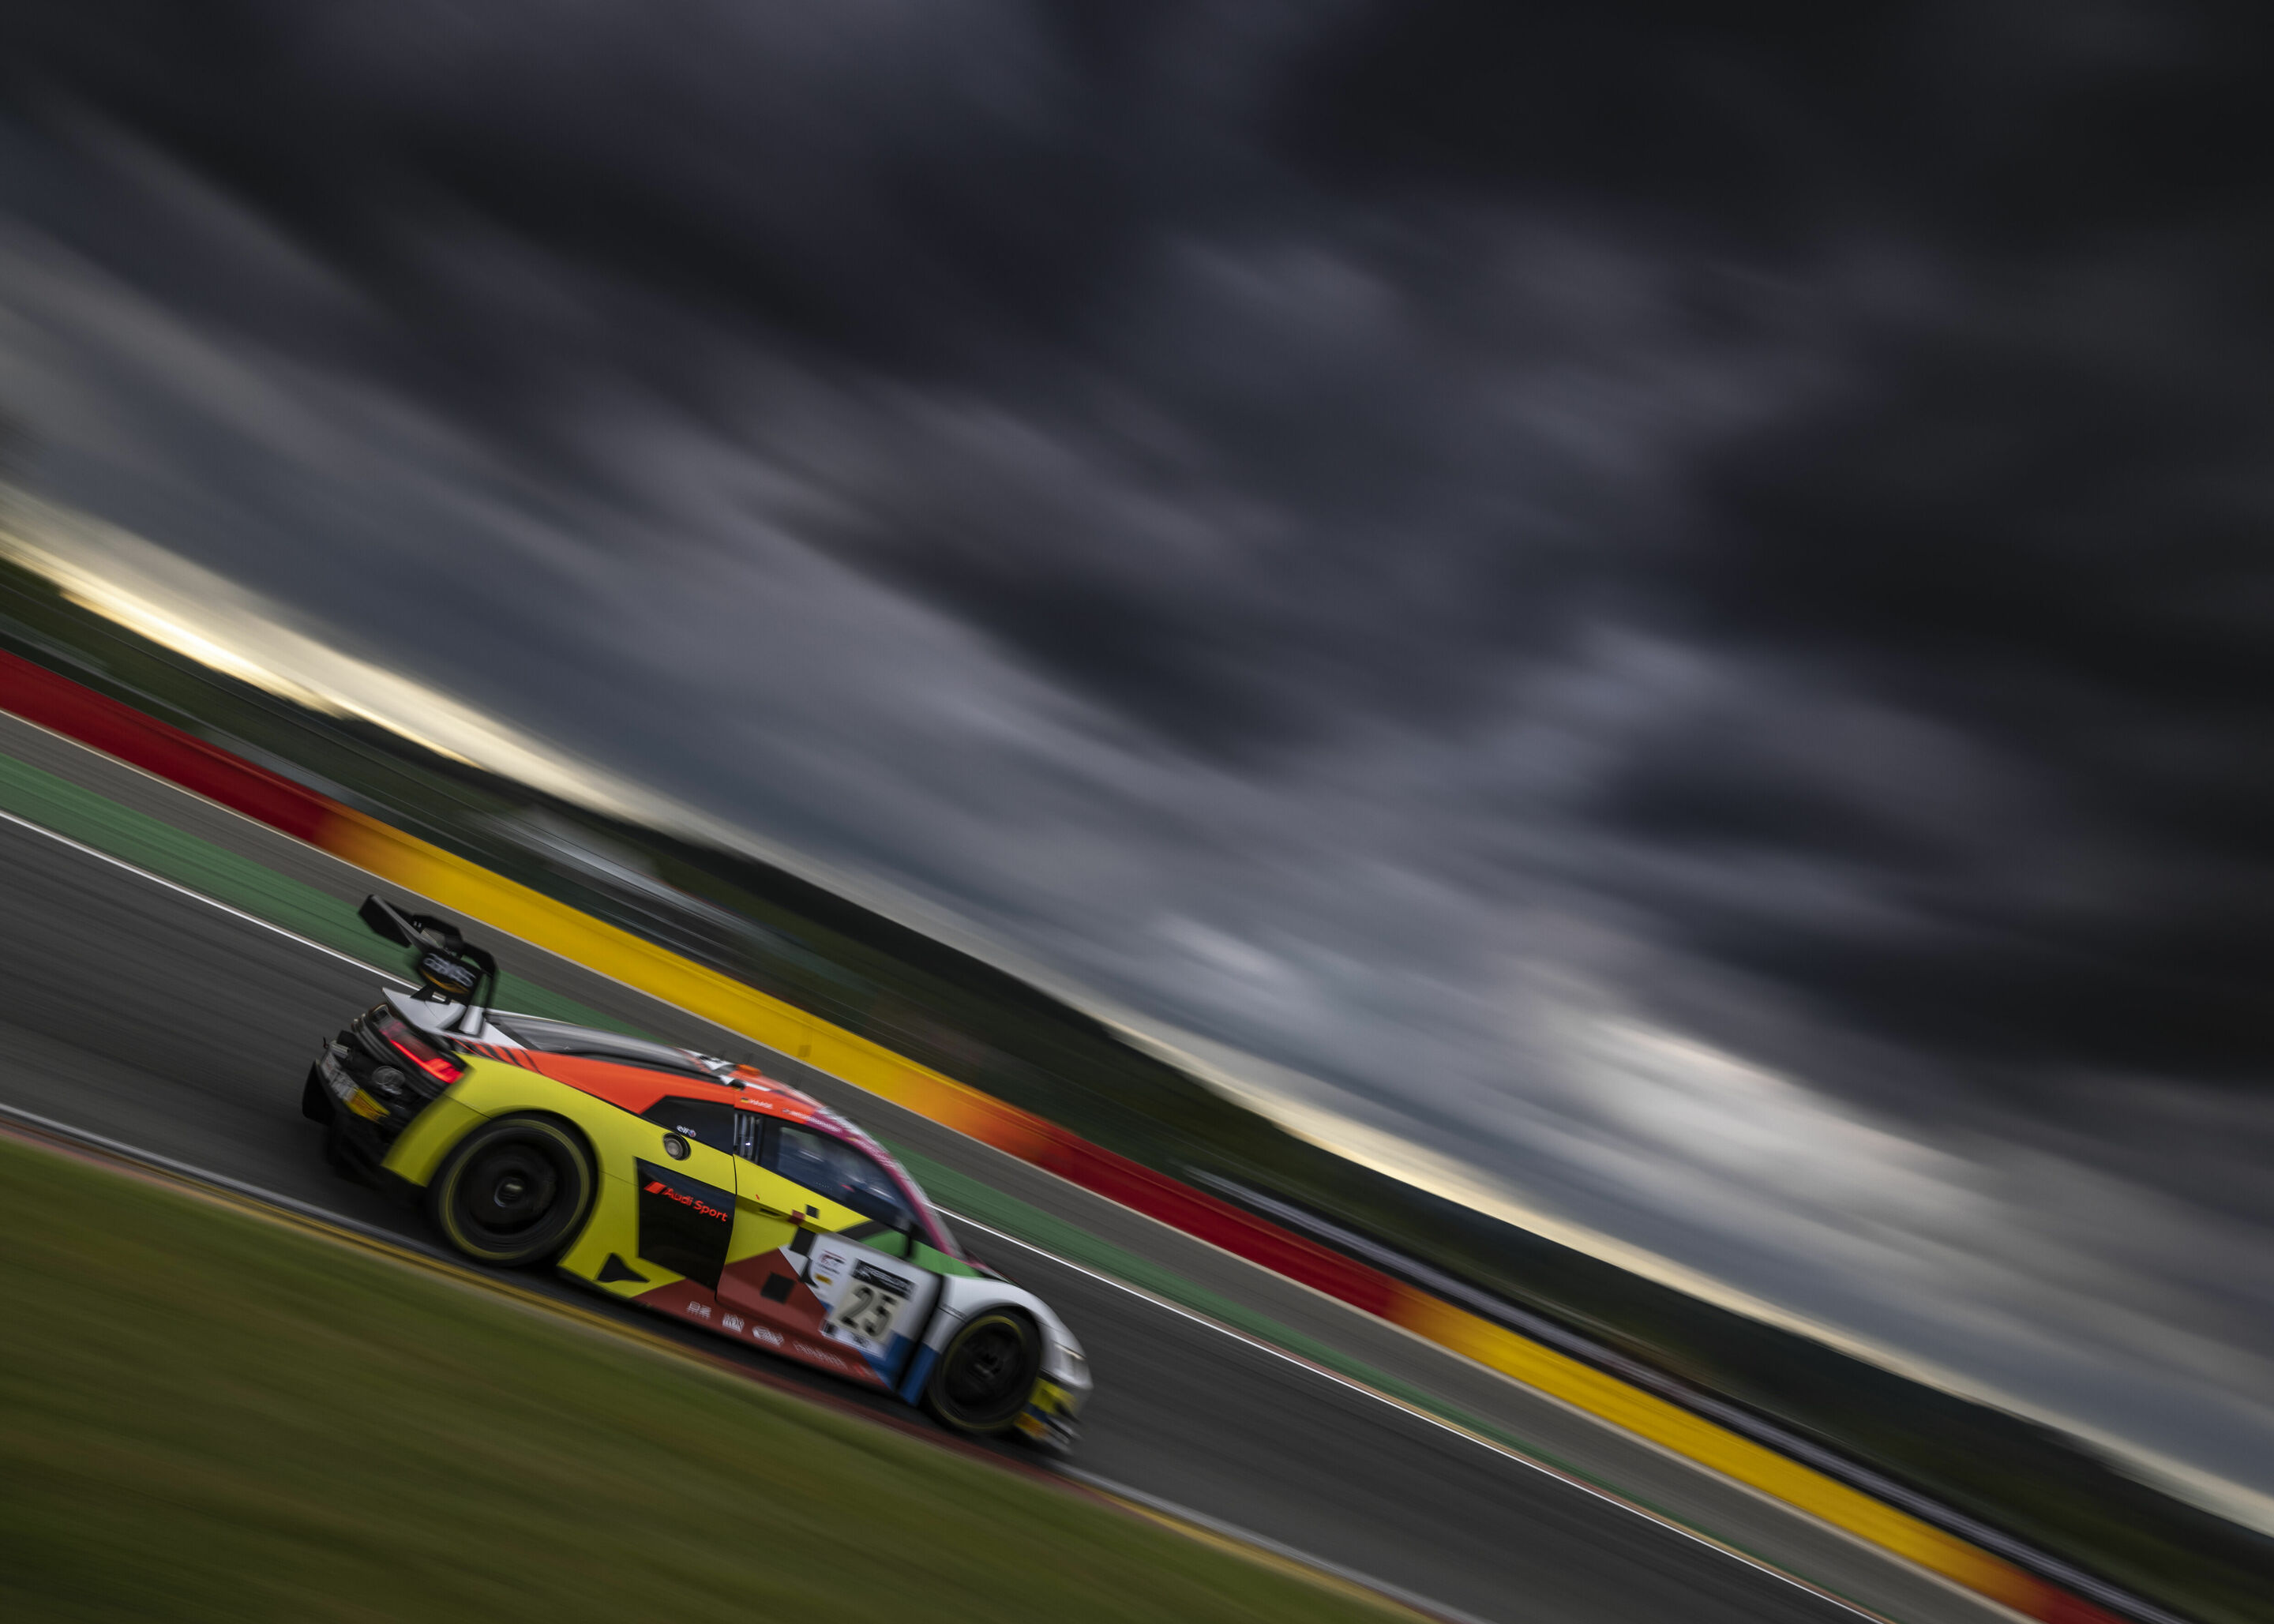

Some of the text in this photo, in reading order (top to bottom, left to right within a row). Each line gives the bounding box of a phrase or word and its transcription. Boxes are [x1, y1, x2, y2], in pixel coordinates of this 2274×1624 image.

[677, 1125, 689, 1135] elf
[662, 1188, 728, 1221] Audi Sport
[839, 1285, 896, 1337] 25
